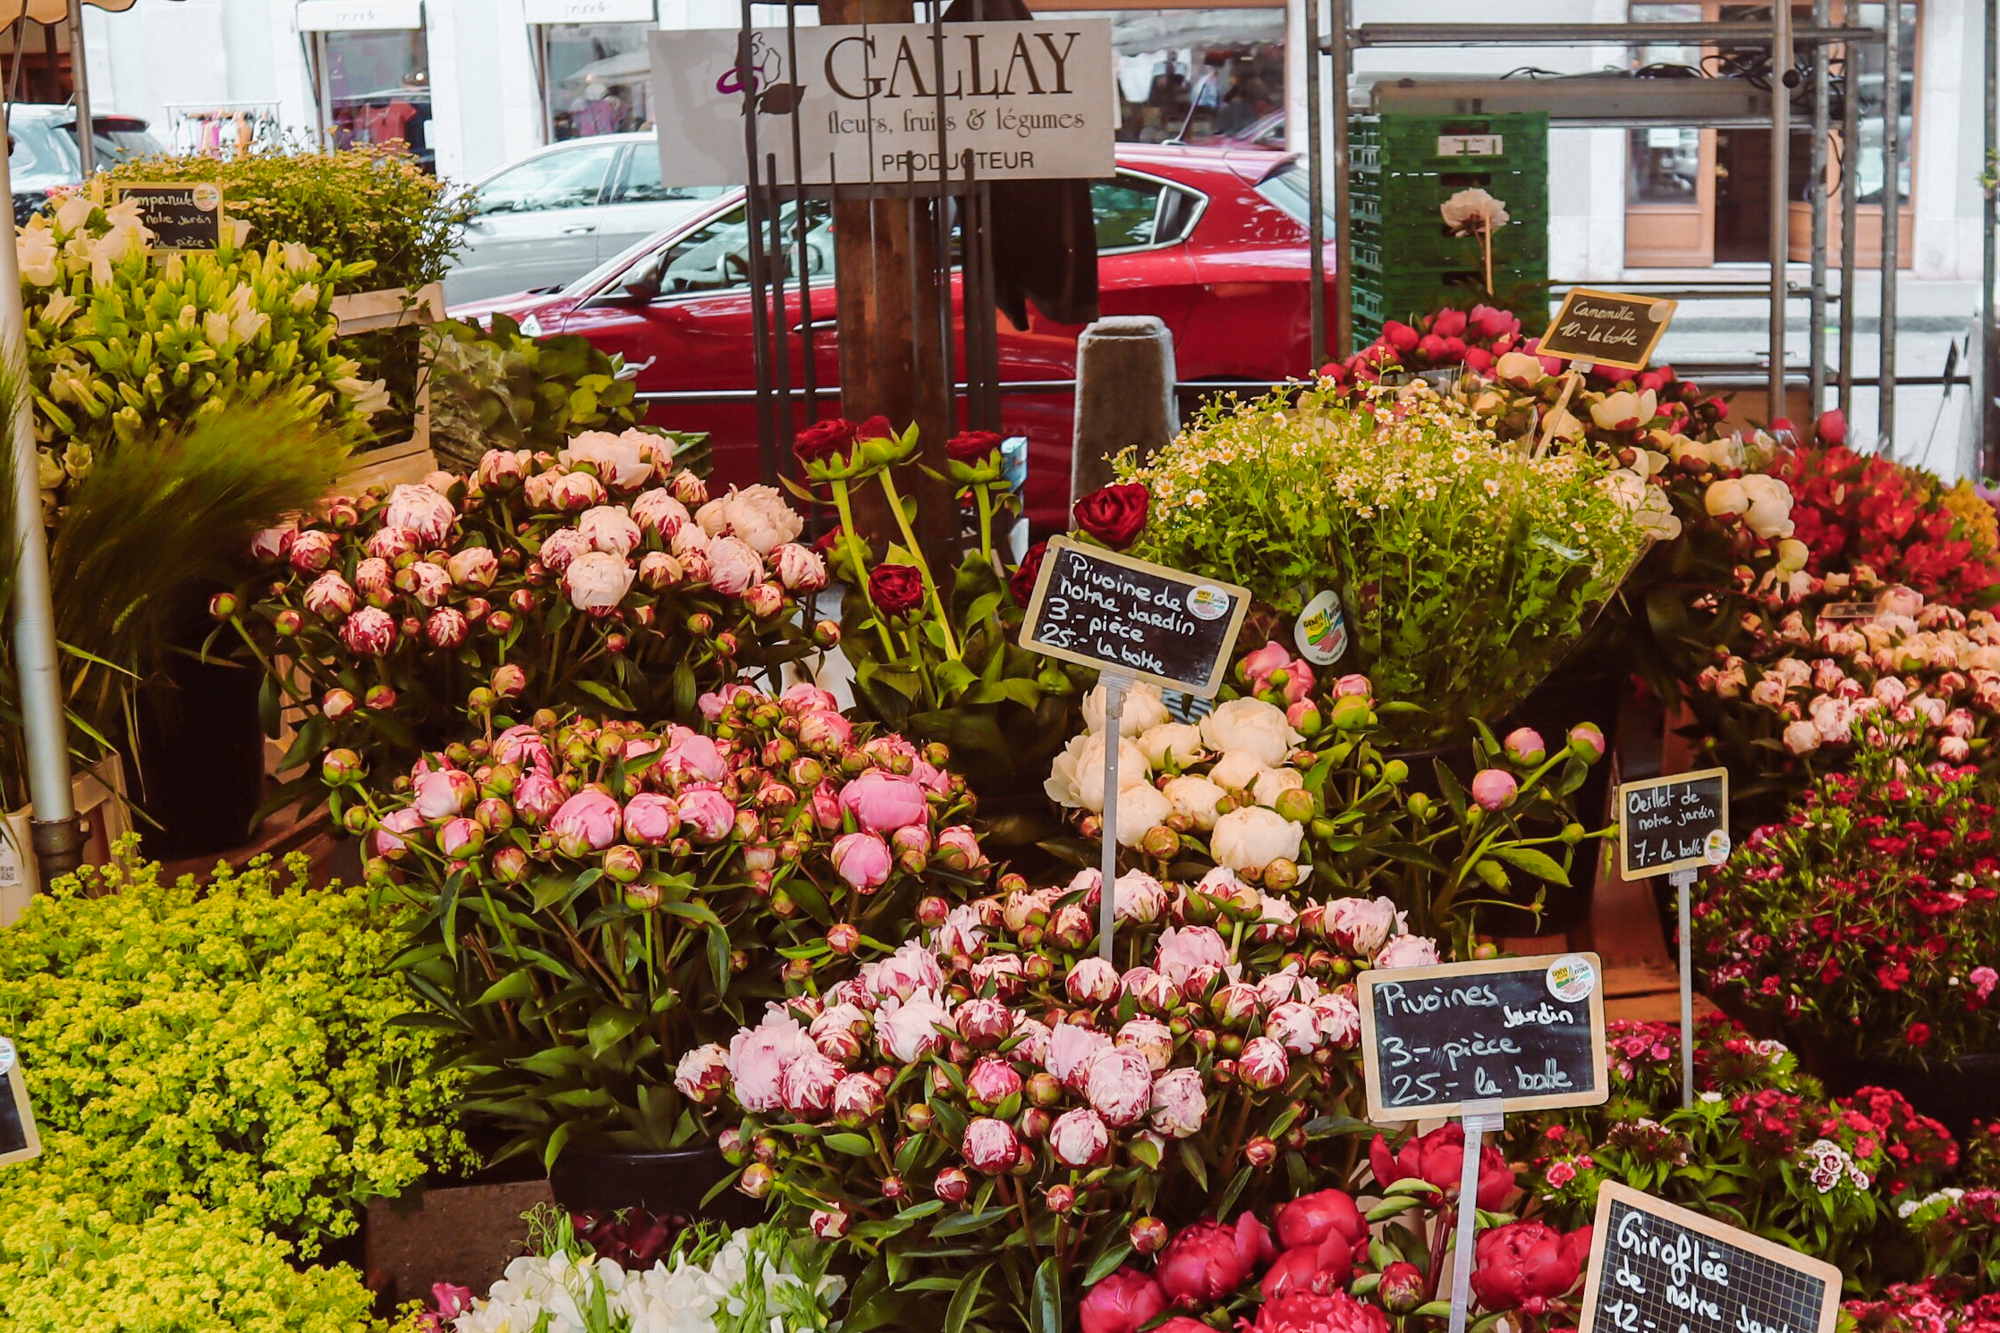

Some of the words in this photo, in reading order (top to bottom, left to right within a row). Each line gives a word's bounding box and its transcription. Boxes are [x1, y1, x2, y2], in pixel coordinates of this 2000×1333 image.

[824, 32, 1081, 100] GALLAY
[903, 108, 957, 132] fruis
[966, 108, 987, 131] &
[996, 107, 1085, 138] légumes
[1602, 326, 1638, 346] botte
[1060, 572, 1120, 613] notre
[1069, 553, 1151, 601] Pivoine
[1153, 586, 1182, 612] de
[1089, 615, 1145, 643] pièce
[1097, 637, 1118, 659] la
[1121, 645, 1166, 675] botte
[1628, 784, 1675, 814] Oeillet
[1680, 784, 1701, 805] de
[1638, 813, 1673, 830] notre
[1661, 838, 1676, 860] la
[1375, 983, 1499, 1017] Pivoines
[1442, 1031, 1522, 1072] pièce
[1473, 1065, 1503, 1096] la
[1514, 1057, 1573, 1091] botte
[1617, 1212, 1729, 1287] Giroflée
[1614, 1254, 1647, 1295] de
[1665, 1284, 1722, 1321] notre
